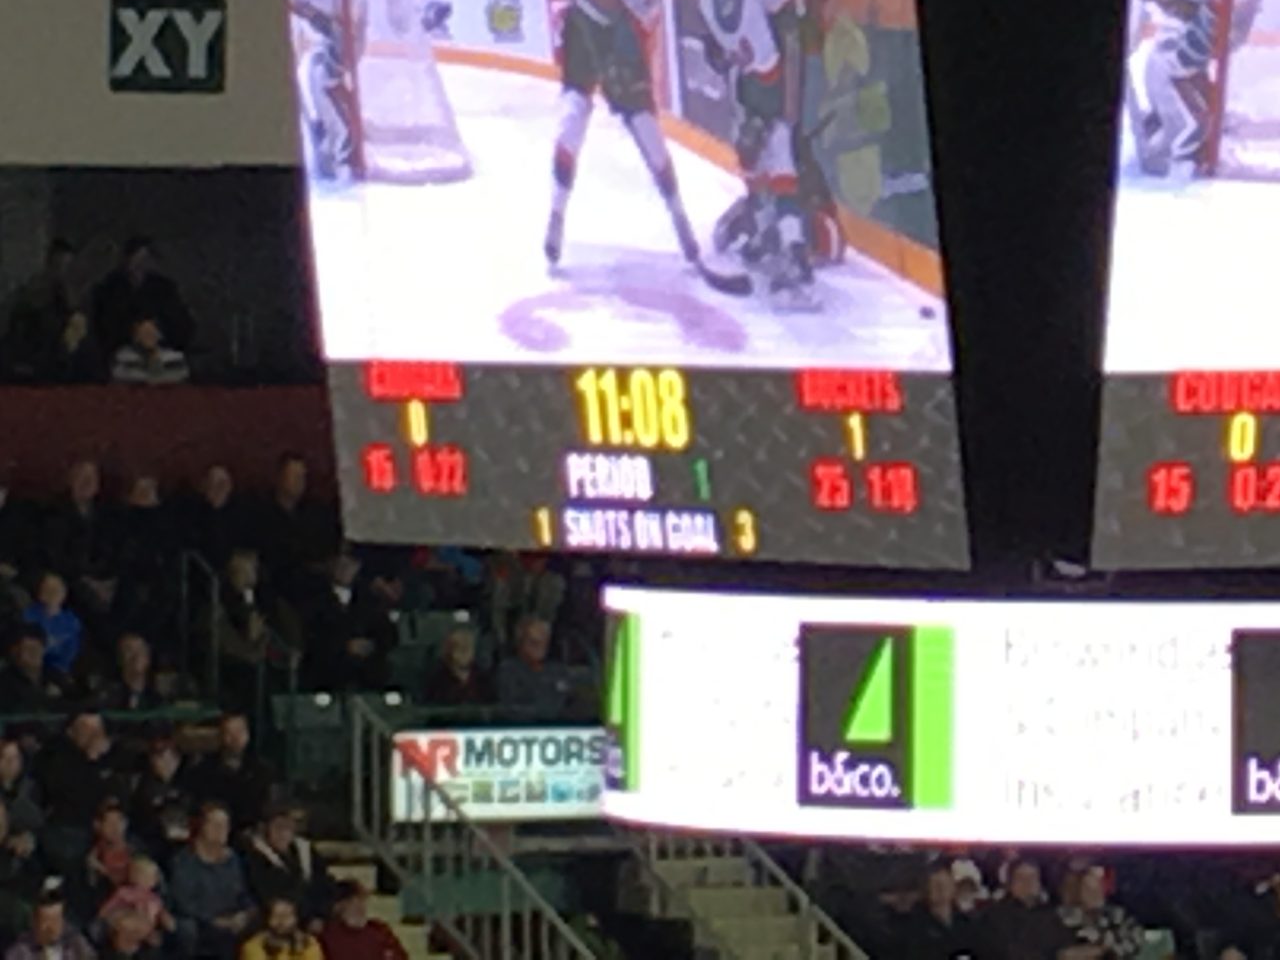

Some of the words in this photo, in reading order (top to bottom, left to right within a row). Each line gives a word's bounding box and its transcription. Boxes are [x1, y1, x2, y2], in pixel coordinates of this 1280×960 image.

[112, 7, 222, 79] XY
[576, 367, 689, 451] 11:08
[848, 411, 865, 461] 1
[1230, 411, 1256, 462] 0
[566, 451, 654, 501] PERIOD
[692, 459, 711, 500] 1
[1152, 464, 1193, 513] 15
[735, 509, 756, 552] 3
[465, 735, 609, 767] MOTORS
[809, 750, 901, 797] b&co.
